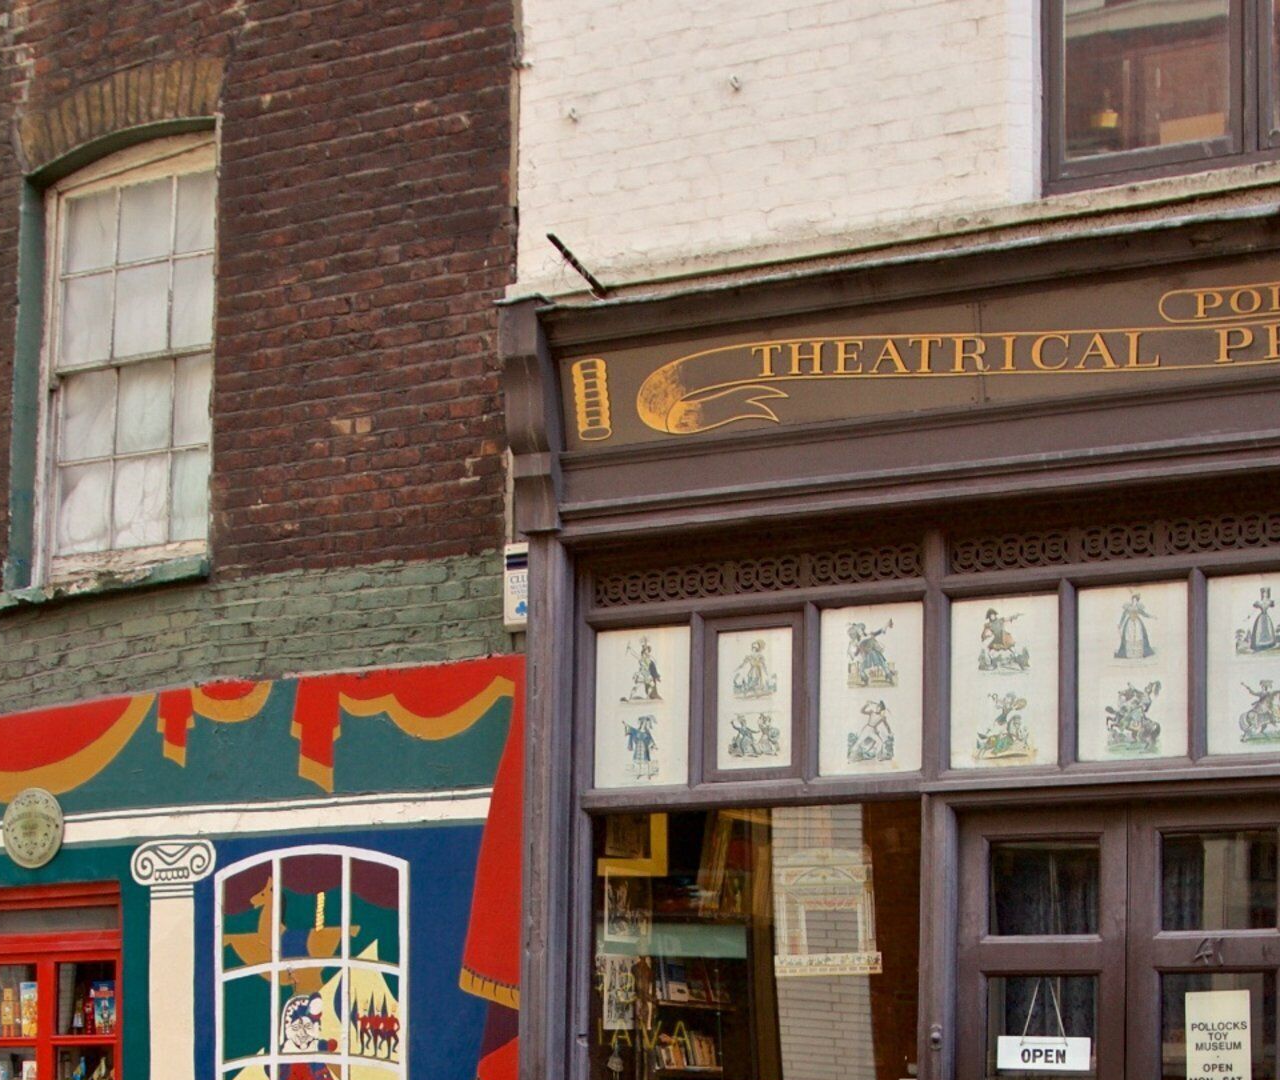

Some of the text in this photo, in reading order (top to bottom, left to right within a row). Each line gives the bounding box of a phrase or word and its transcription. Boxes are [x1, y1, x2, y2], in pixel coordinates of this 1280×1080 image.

[751, 331, 1160, 378] THEATRICAL
[1191, 1021, 1247, 1032] POLLOCKS
[1208, 1032, 1228, 1041] TOY
[1195, 1041, 1242, 1052] MUSEUM
[1021, 1048, 1066, 1065] OPEN
[1203, 1063, 1233, 1073] OPEN
